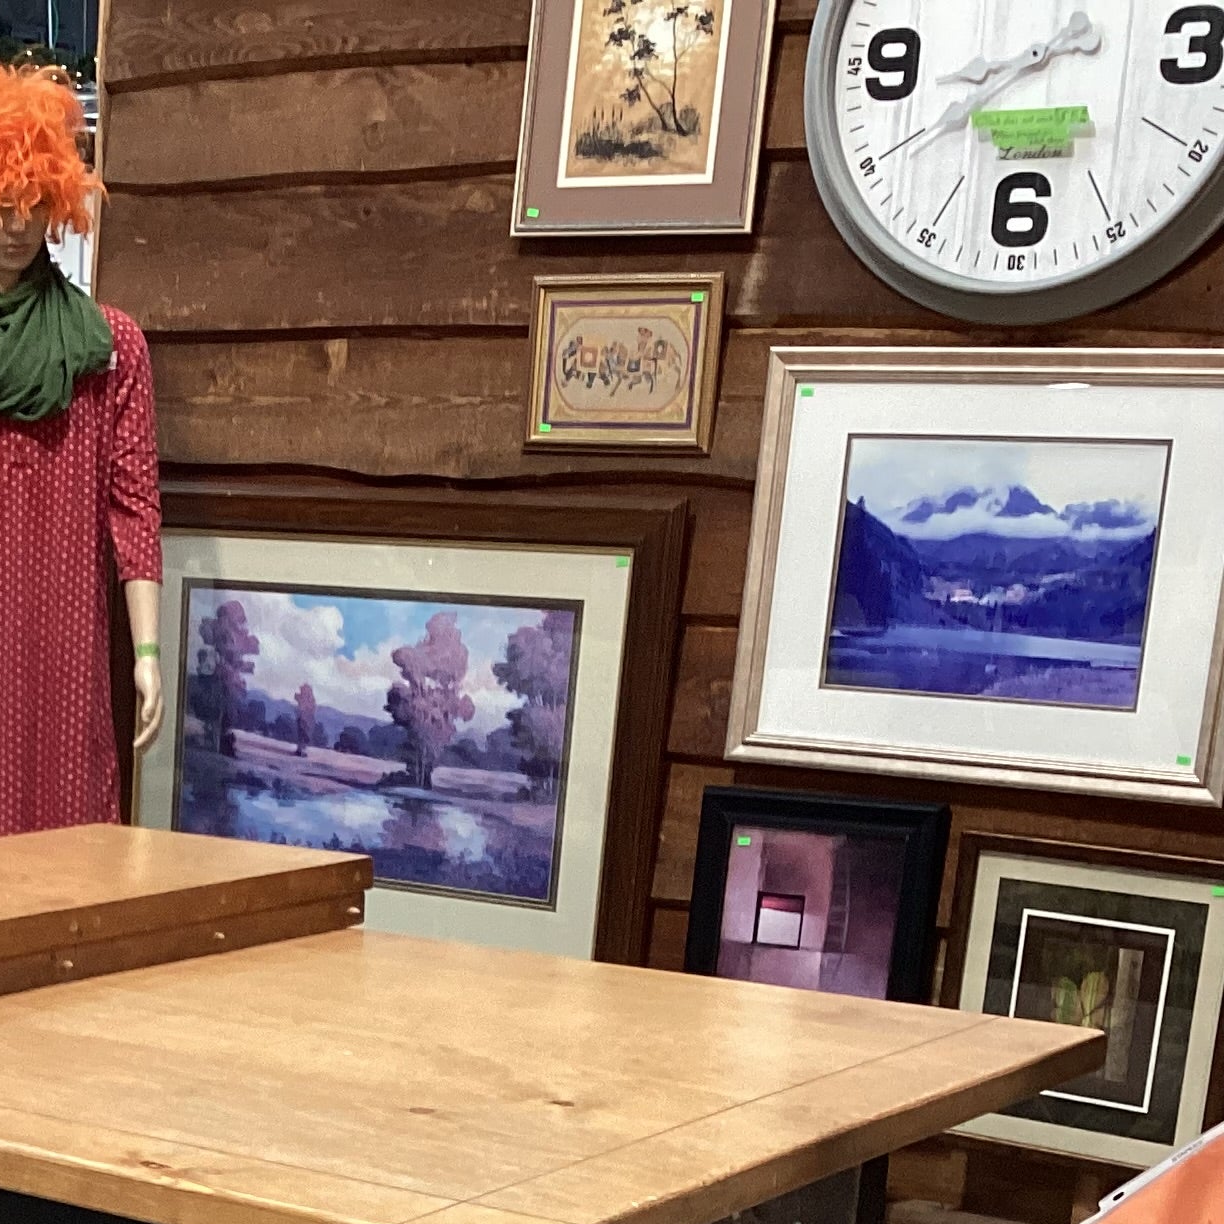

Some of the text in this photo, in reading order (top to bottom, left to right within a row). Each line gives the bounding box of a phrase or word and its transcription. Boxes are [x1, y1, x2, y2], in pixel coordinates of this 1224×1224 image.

[1160, 5, 1224, 84] 3
[847, 57, 862, 76] 45
[865, 27, 921, 101] 9
[1188, 139, 1209, 163] 20
[859, 157, 876, 176] 40
[991, 171, 1052, 248] 6
[916, 228, 936, 248] 35
[1106, 221, 1126, 243] 25
[1007, 254, 1025, 271] 30
